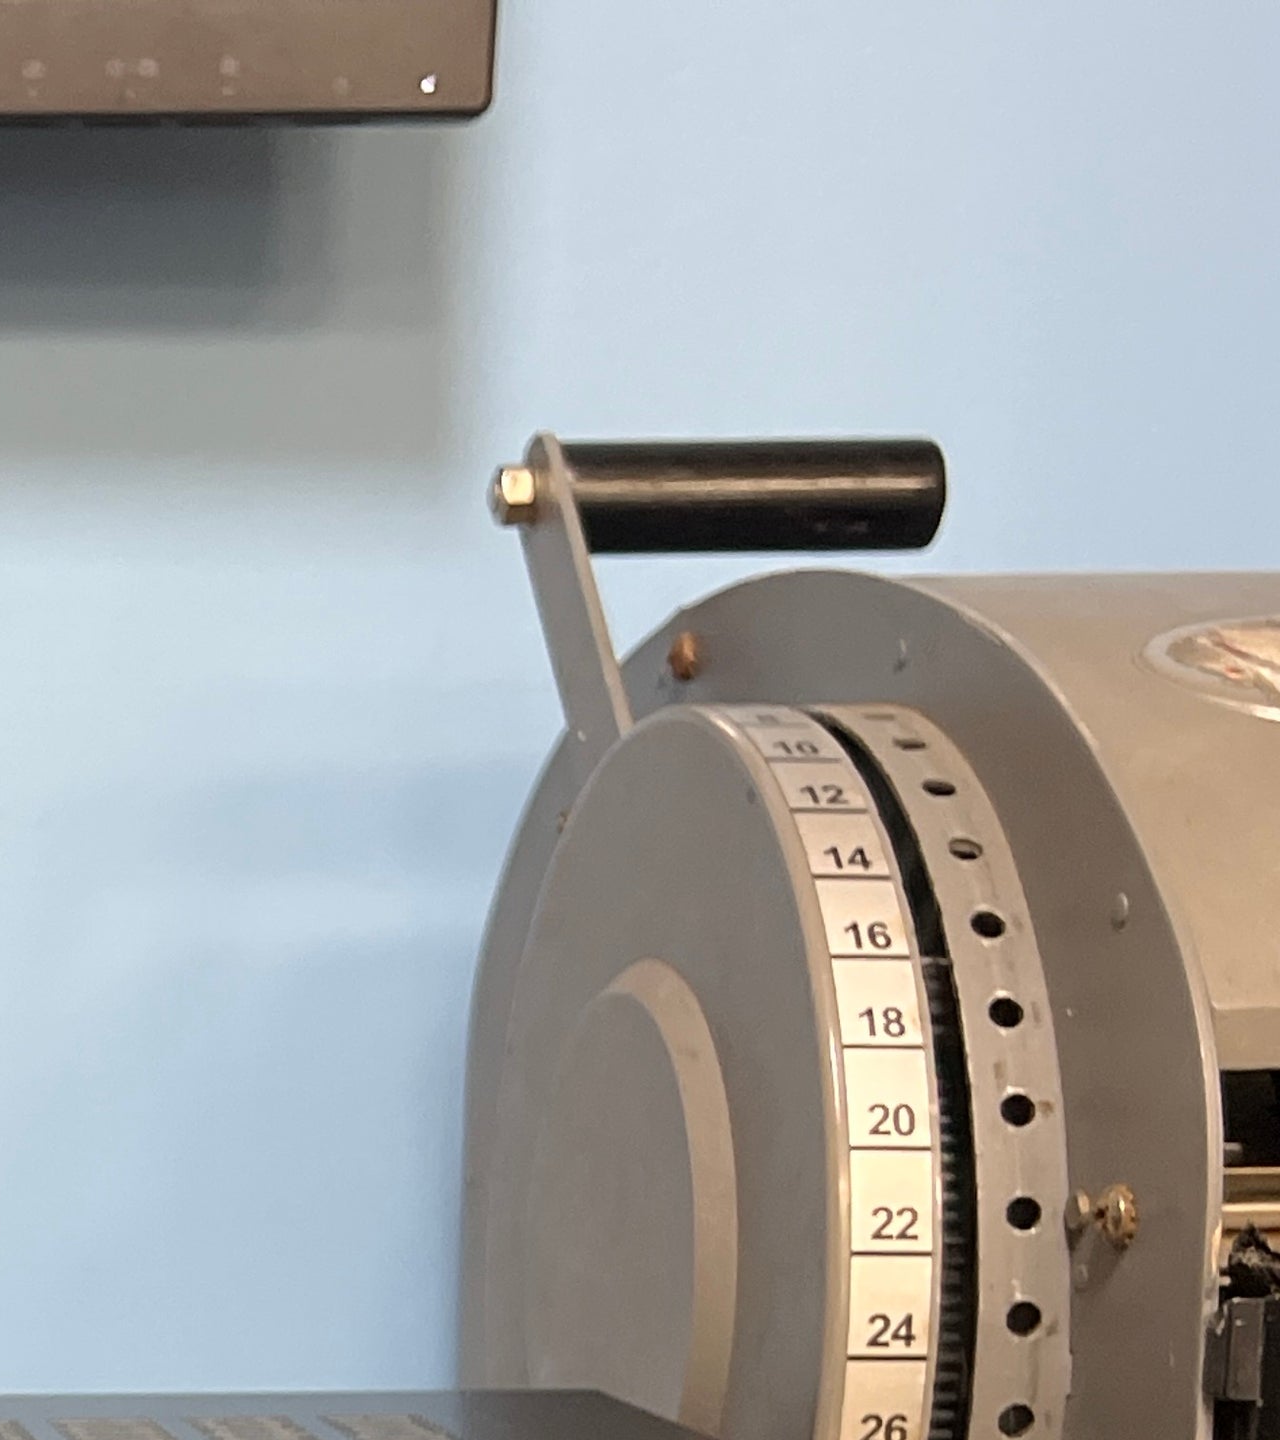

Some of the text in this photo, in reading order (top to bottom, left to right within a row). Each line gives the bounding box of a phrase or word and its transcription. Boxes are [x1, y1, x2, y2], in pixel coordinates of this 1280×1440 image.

[800, 784, 849, 804] 12
[824, 845, 872, 870] 14
[844, 921, 892, 949] 16
[858, 1007, 906, 1037] 18
[868, 1103, 915, 1136] 20
[871, 1207, 919, 1240] 22
[867, 1313, 916, 1347] 24
